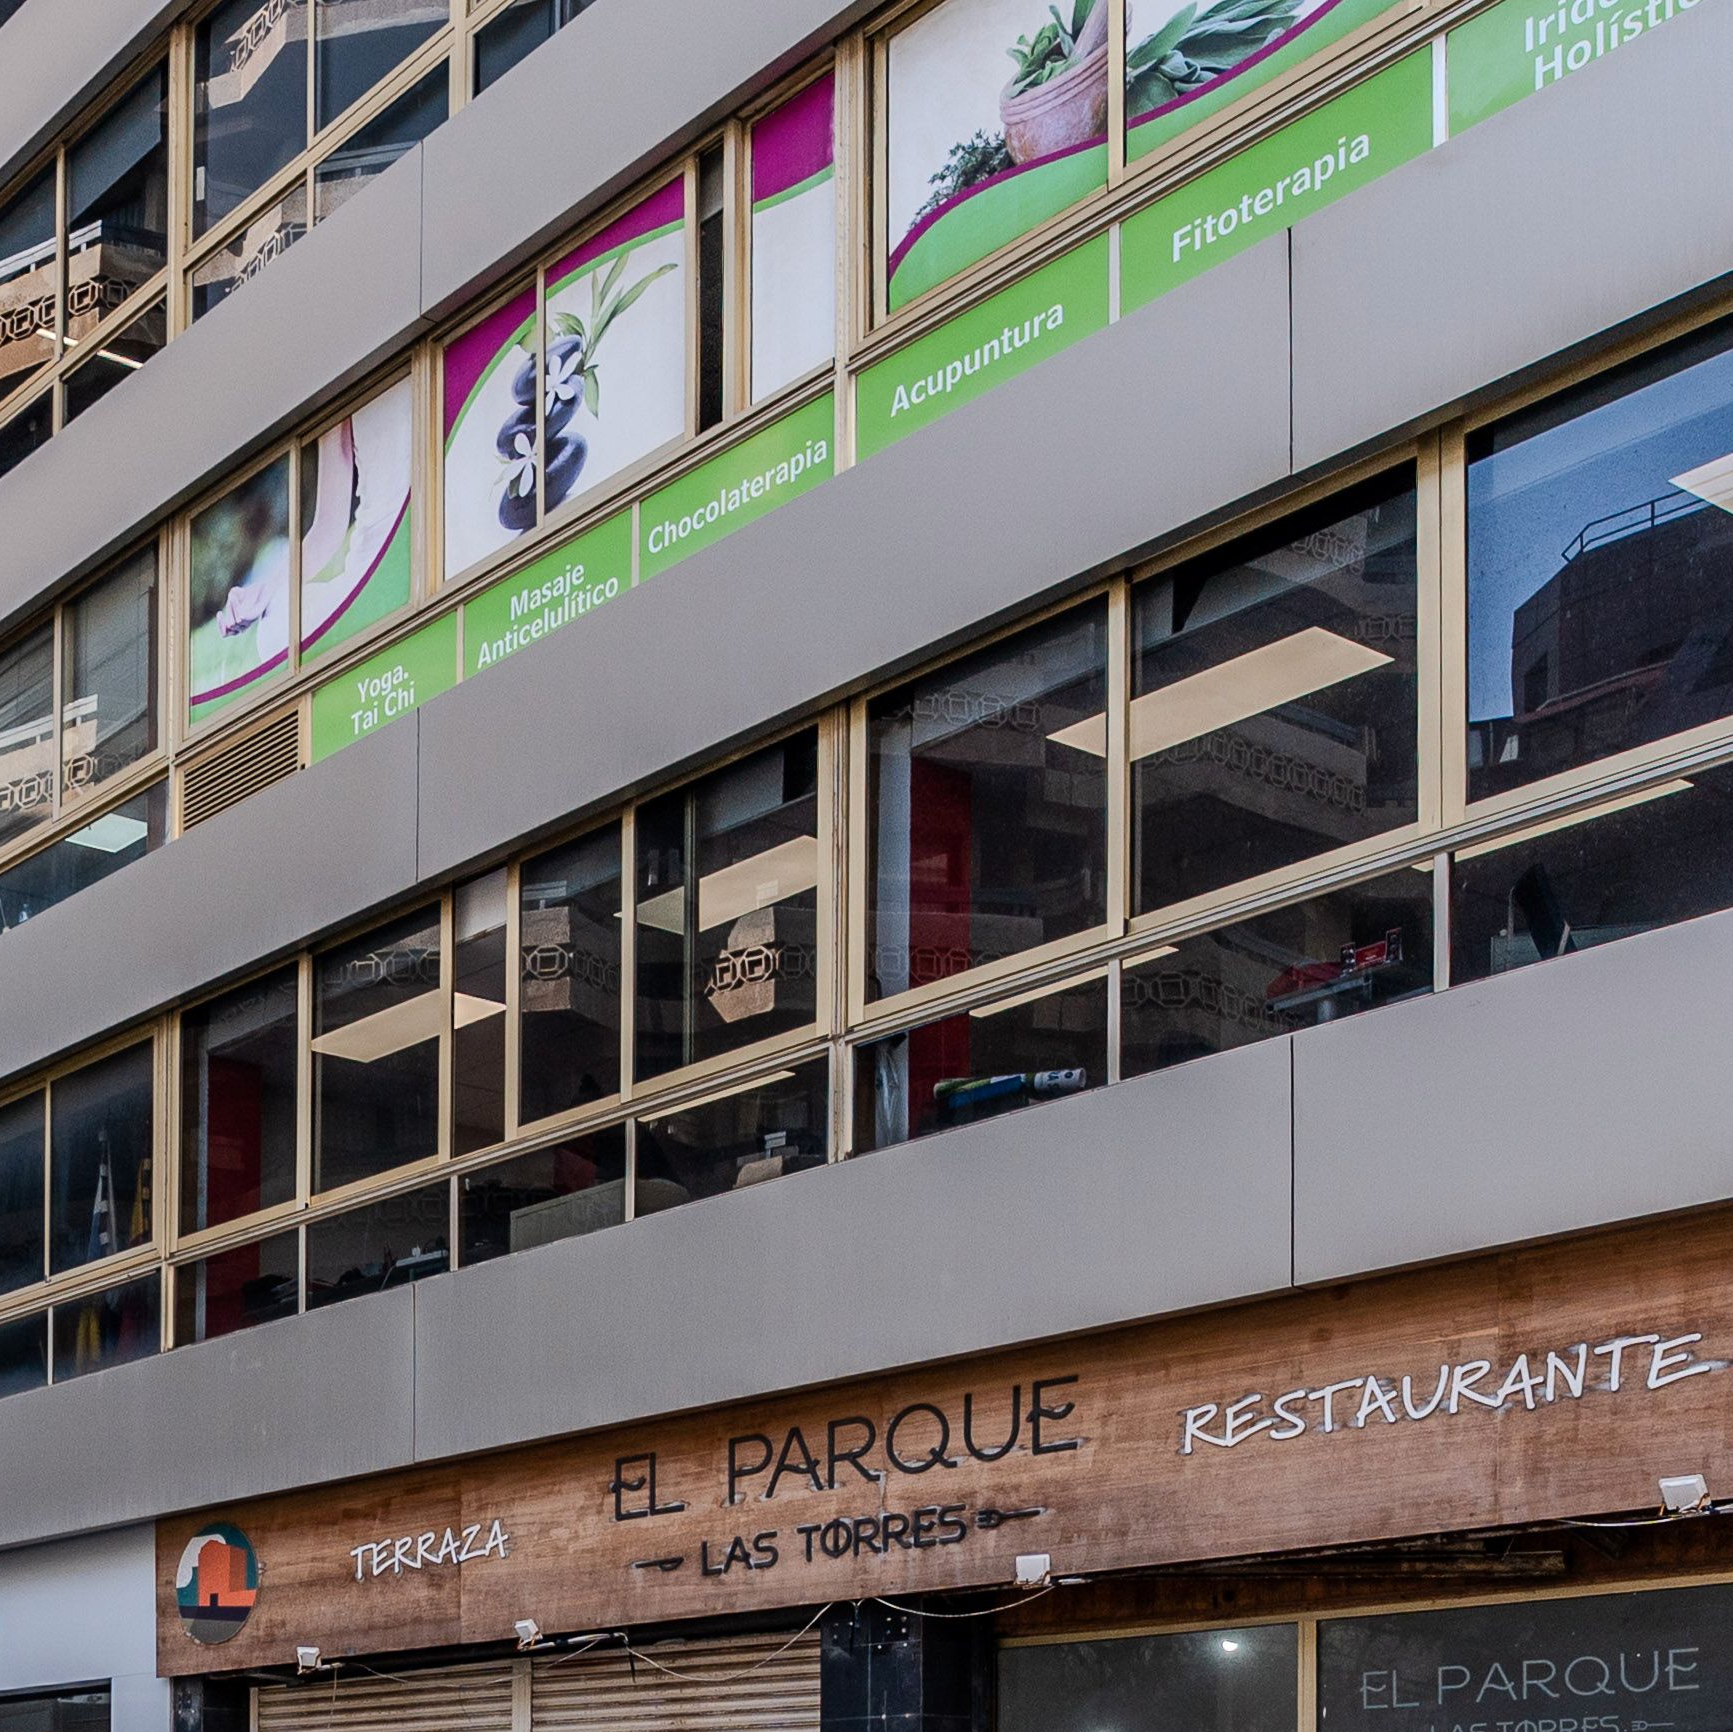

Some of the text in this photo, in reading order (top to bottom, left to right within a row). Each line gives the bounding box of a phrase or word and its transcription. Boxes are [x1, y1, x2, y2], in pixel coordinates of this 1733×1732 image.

[1171, 132, 1371, 263] Fitoterapia
[889, 302, 1065, 418] Acupuntura
[648, 440, 827, 554] Chocolaterapia
[477, 577, 618, 669] Anticelulítico
[510, 564, 584, 621] Masaje
[351, 681, 415, 735] Tai Chi
[1183, 1333, 1711, 1454] RESTAURANTE
[610, 1375, 1080, 1521] EL PARQUE
[350, 1519, 510, 1581] TERRAZA
[701, 1504, 967, 1576] LAS TORRES
[1360, 1648, 1700, 1710] EL PARQUE
